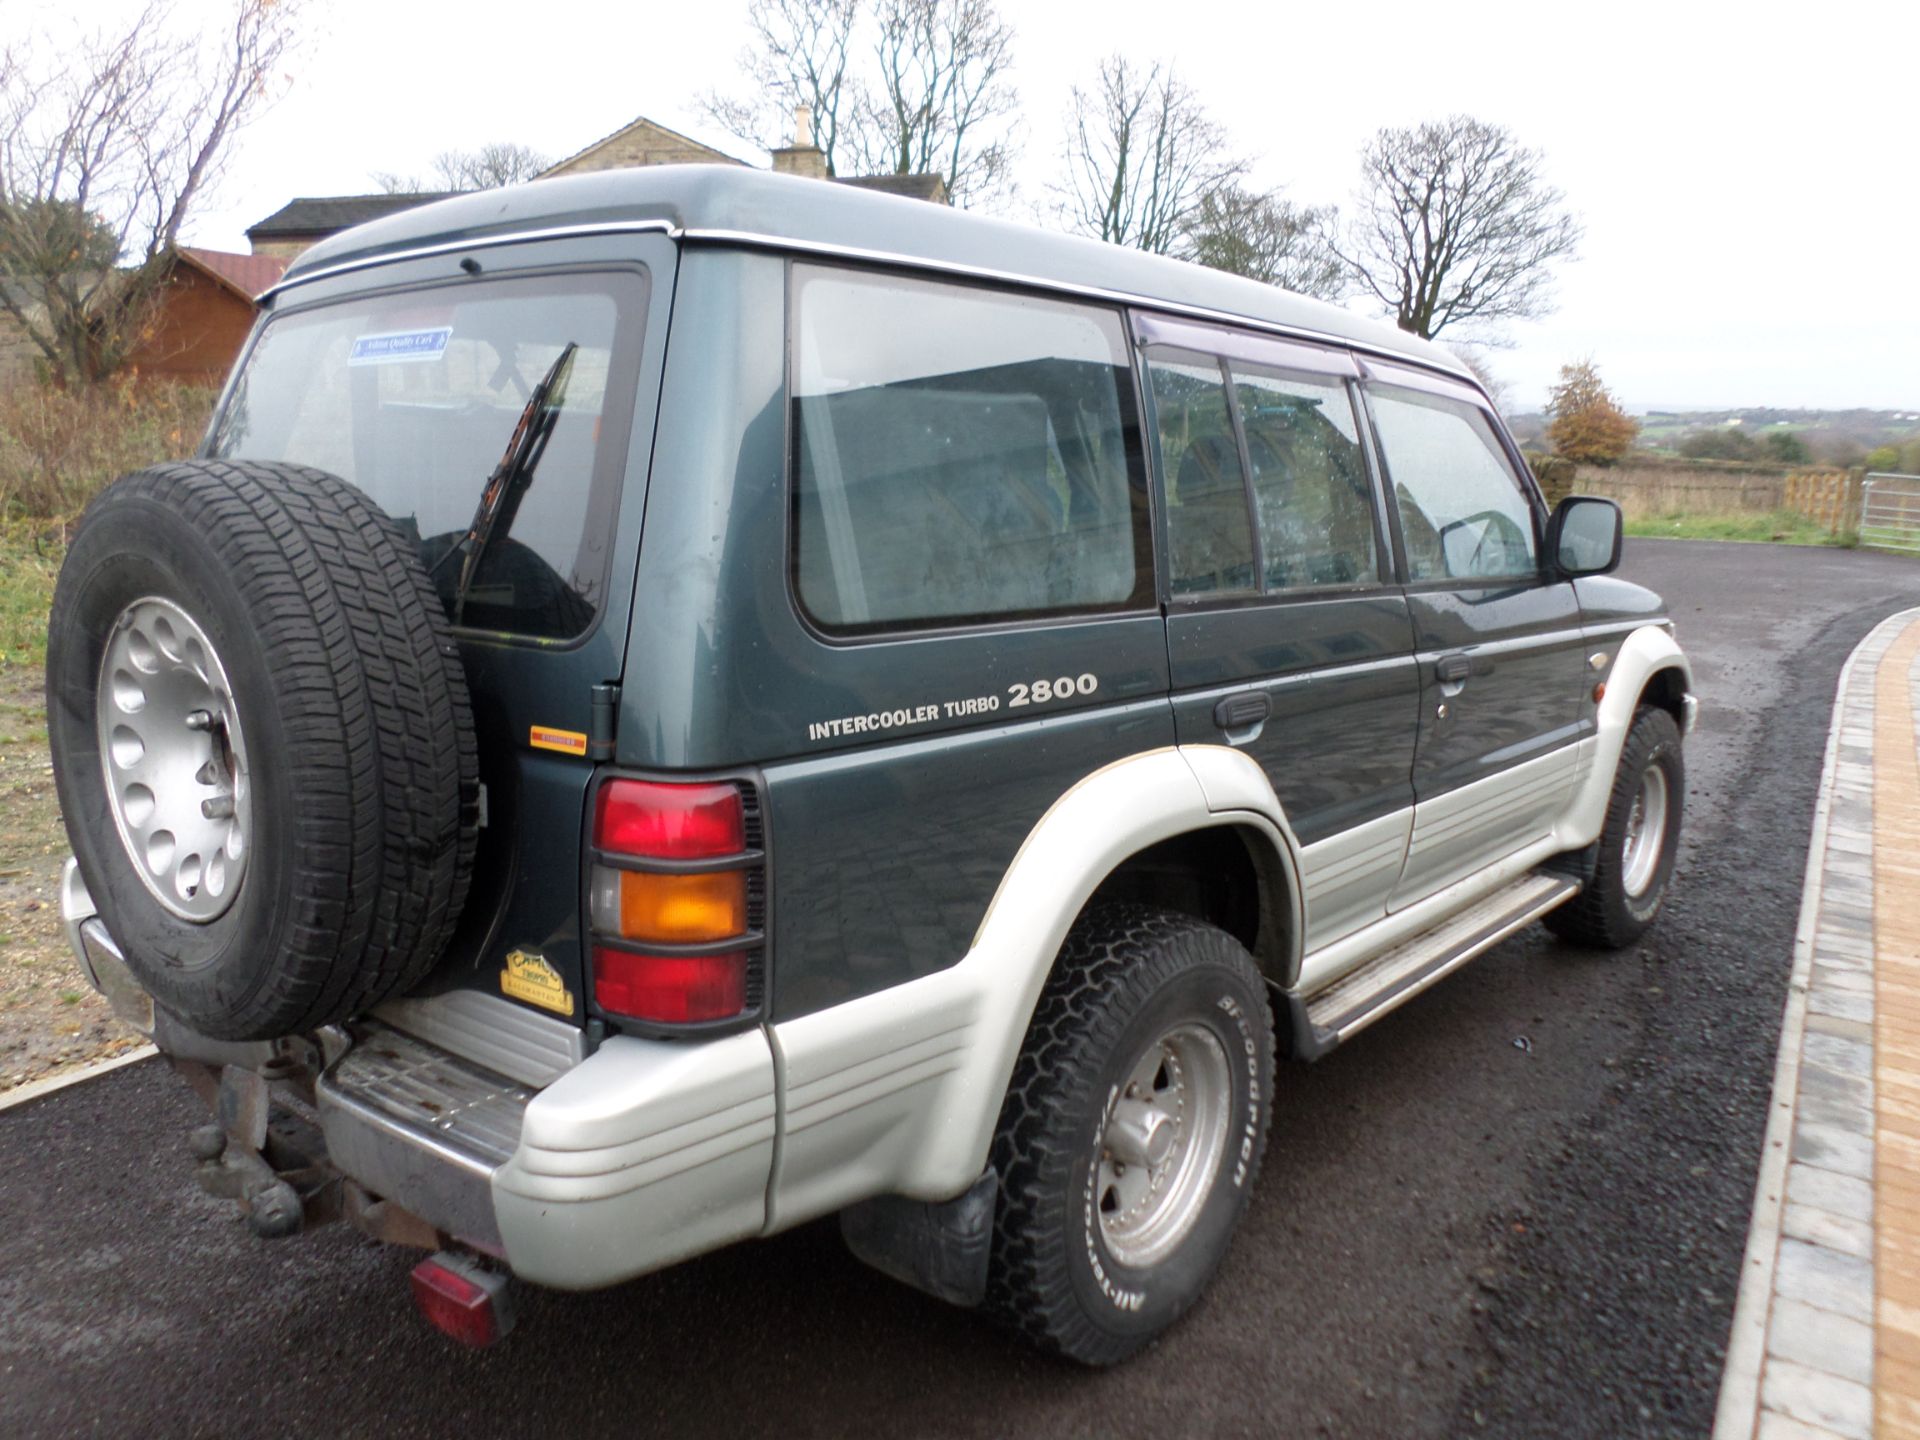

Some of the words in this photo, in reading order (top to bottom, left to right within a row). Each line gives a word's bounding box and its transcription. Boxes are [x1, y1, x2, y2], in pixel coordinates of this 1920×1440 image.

[808, 704, 940, 741] INTERCOOLER
[943, 695, 1000, 718] TURBO
[1008, 673, 1098, 708] 2800
